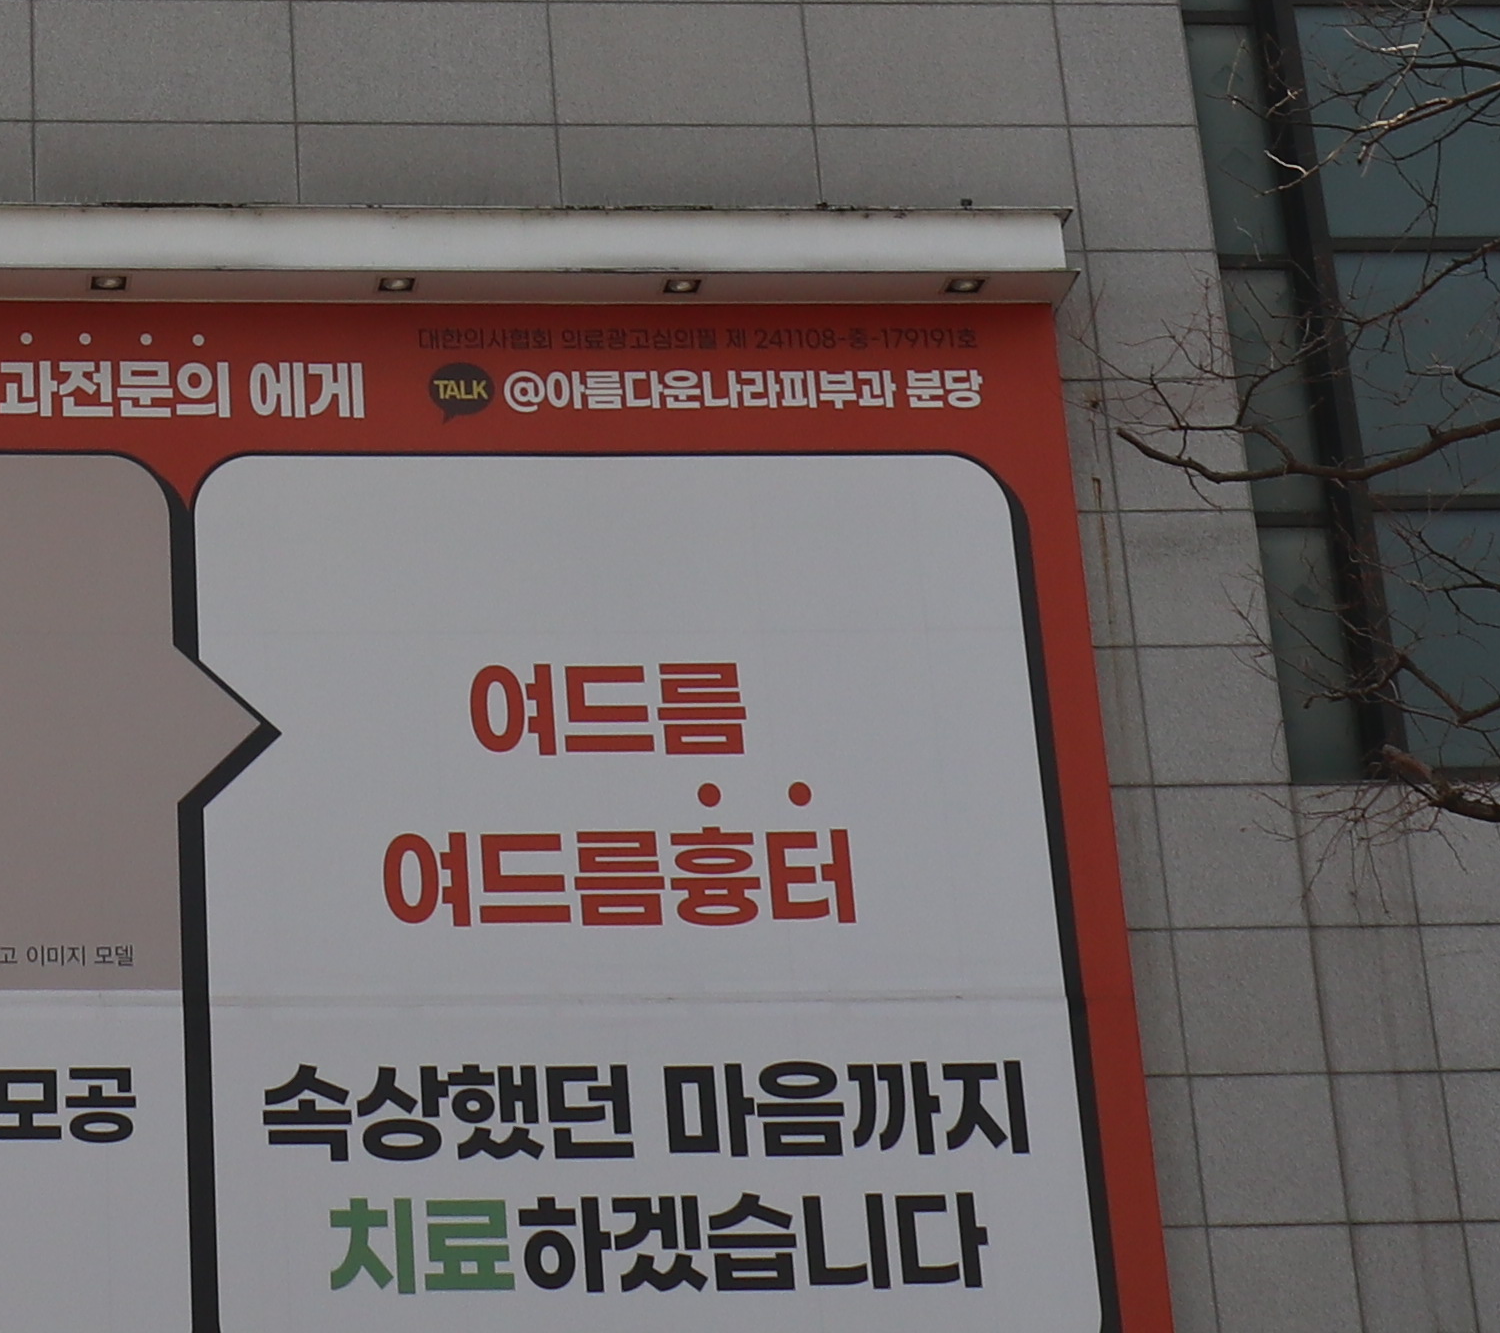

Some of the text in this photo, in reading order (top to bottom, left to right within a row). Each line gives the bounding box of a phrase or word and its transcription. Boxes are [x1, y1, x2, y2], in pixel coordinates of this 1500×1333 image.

[417, 326, 553, 351] 대한의사협회
[726, 326, 747, 351] 제
[249, 359, 367, 422] 에게
[433, 378, 490, 401] TALK
[503, 369, 983, 413] @아름다운나라피부과 분당
[470, 661, 747, 757] 여드름
[383, 825, 858, 928] 여드름흉터
[25, 944, 88, 969] 이미지
[94, 943, 135, 969] 모델
[262, 1059, 1032, 1163] 속상했던 마음까지
[329, 1191, 990, 1296] 치료하겠습니다
